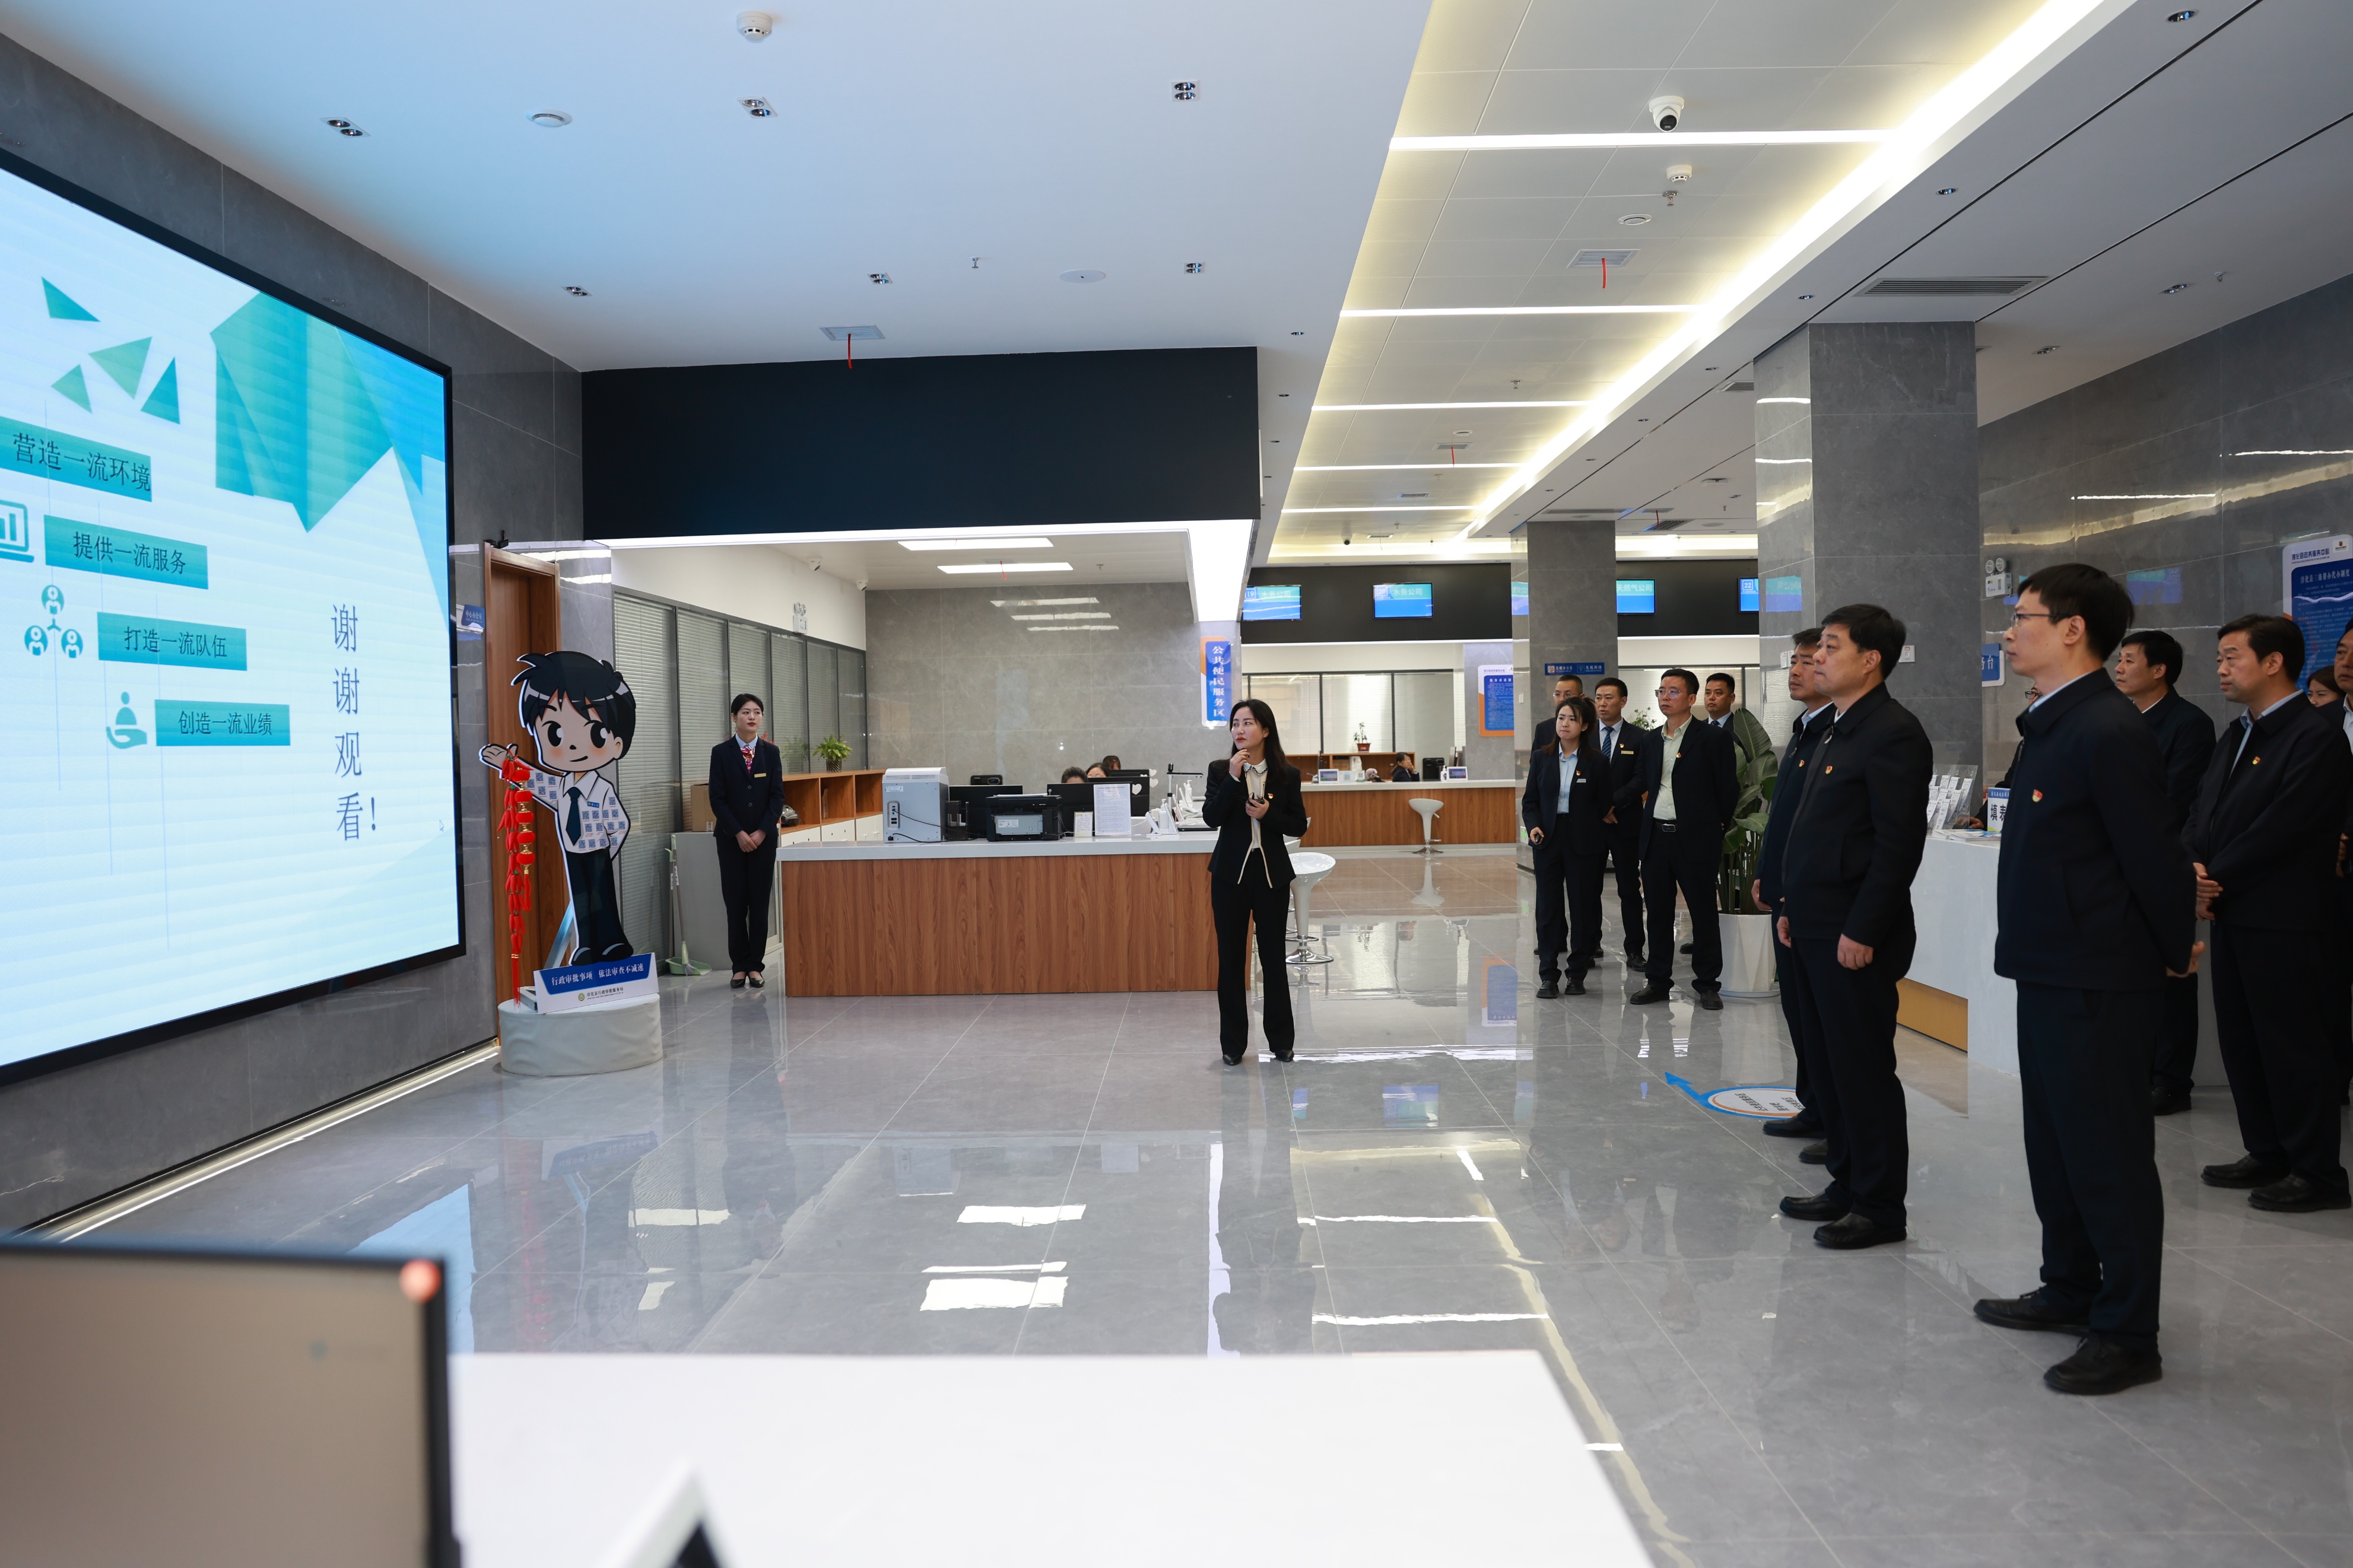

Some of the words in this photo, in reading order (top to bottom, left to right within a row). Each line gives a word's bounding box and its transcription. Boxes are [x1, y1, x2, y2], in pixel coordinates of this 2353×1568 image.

[13, 432, 151, 491] 营造一流环境
[73, 531, 186, 574] 提供一流服务
[124, 626, 227, 658] 打造一流队伍
[1212, 645, 1225, 717] 公共便民服务区
[178, 710, 272, 735] 创造一流业绩
[551, 971, 593, 986] 行政审批事项
[598, 963, 644, 978] 依法审查不减速
[586, 987, 624, 997] 淳化县行政审批服务局
